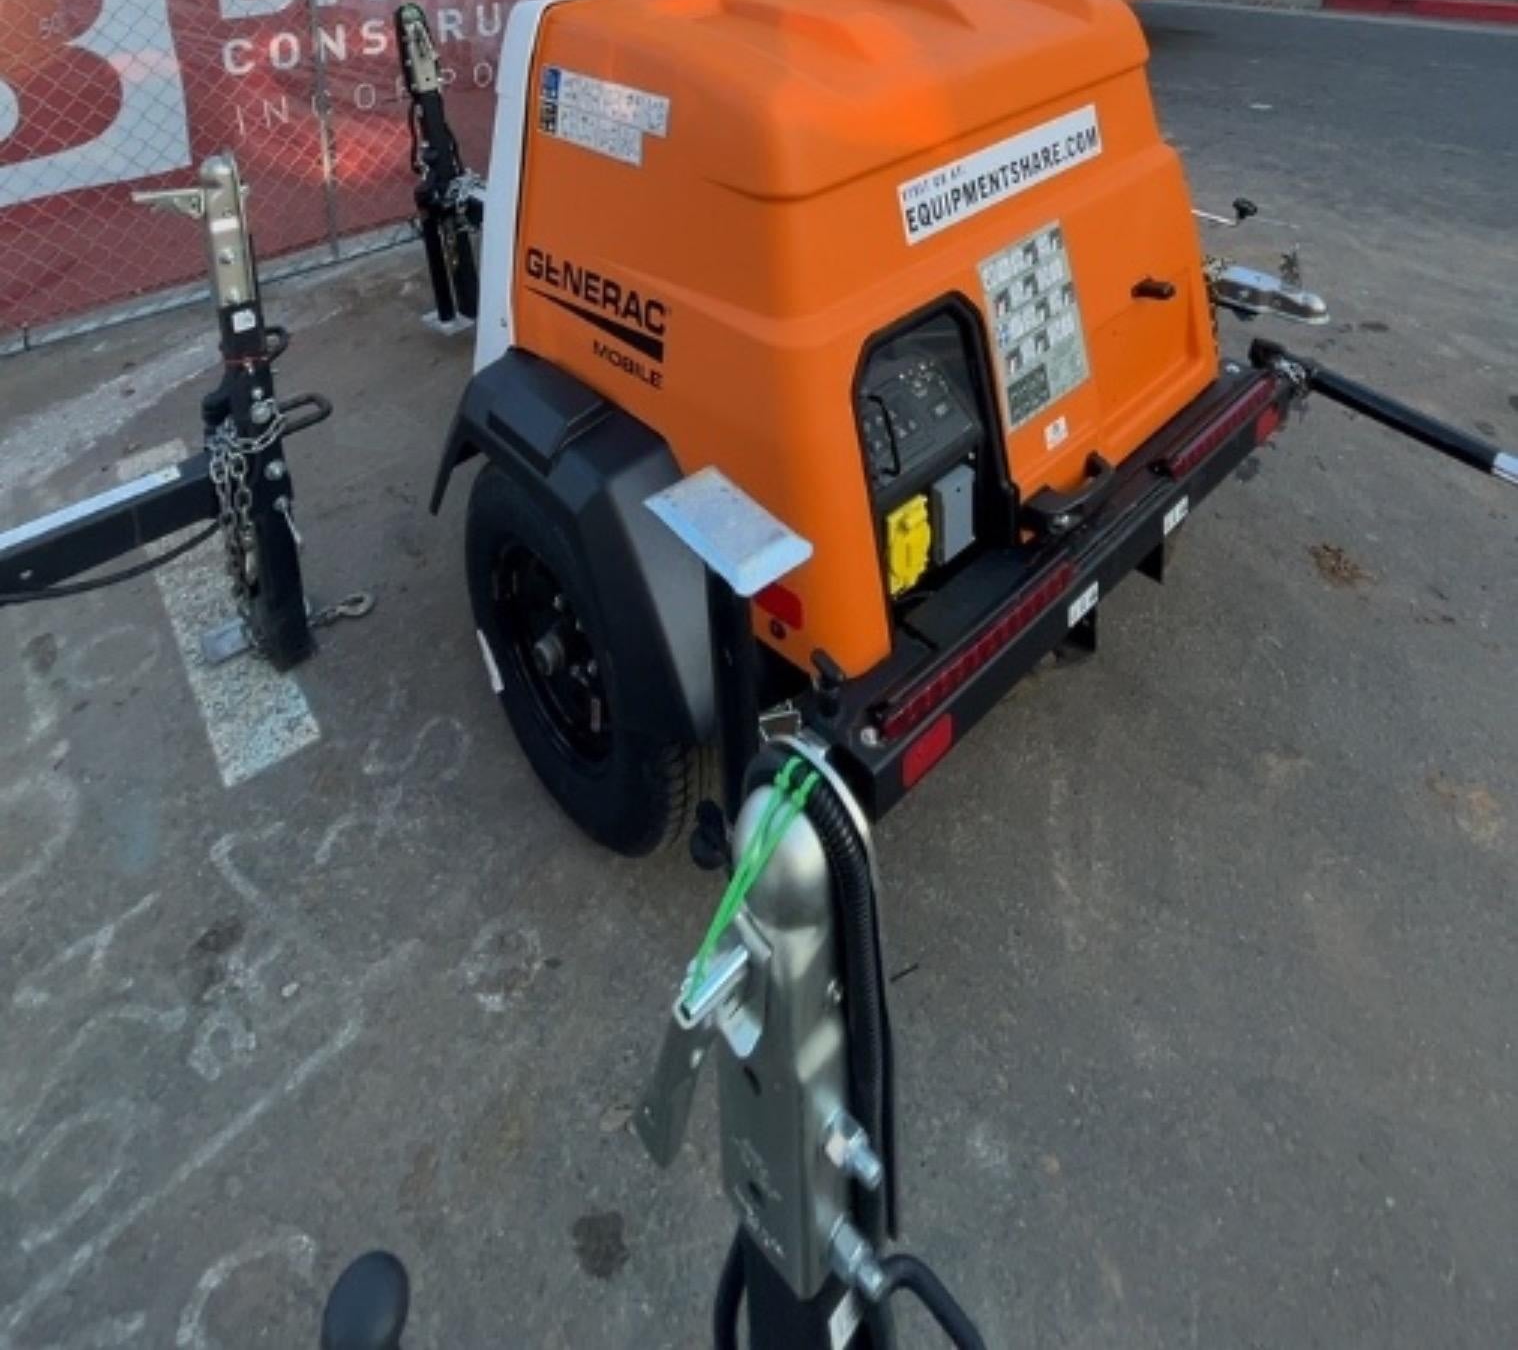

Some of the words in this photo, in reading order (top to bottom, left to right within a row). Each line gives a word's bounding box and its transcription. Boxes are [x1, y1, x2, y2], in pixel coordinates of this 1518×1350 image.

[222, 1, 499, 75] CONSRU
[905, 125, 1097, 233] EQUIPMENTSHARE.COM
[526, 248, 665, 336] GENERAC
[592, 340, 664, 390] MOBILE
